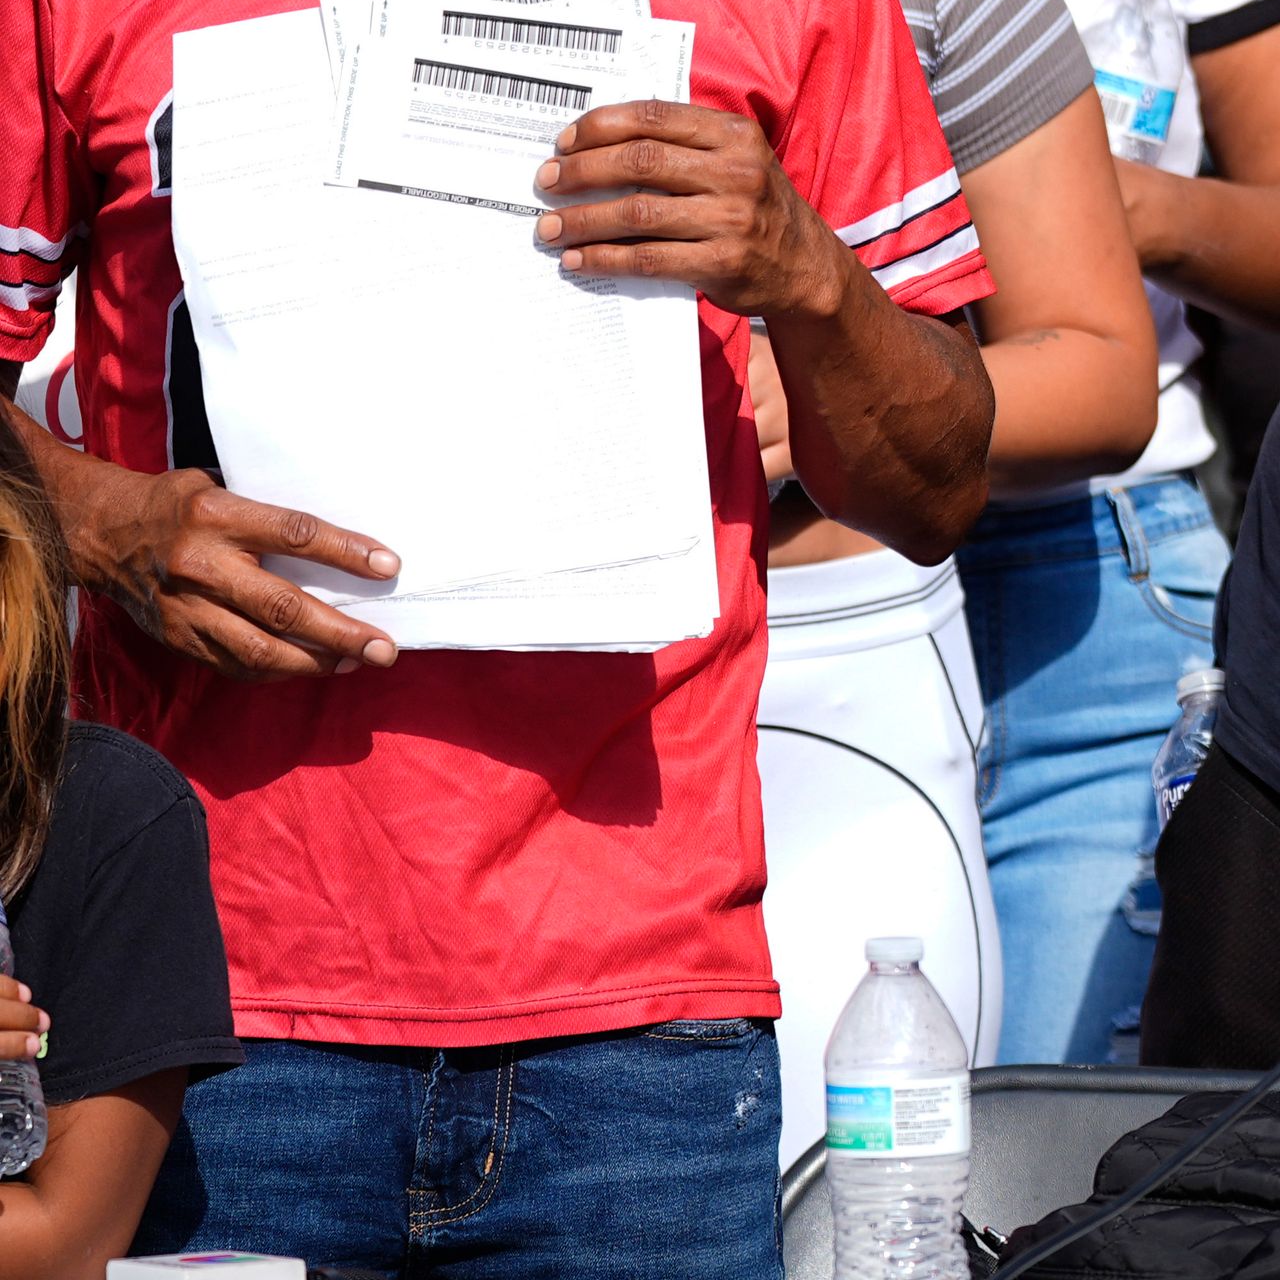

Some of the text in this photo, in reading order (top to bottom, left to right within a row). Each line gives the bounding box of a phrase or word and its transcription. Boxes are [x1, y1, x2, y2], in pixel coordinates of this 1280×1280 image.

[400, 185, 450, 202] NEGOTIABLE
[450, 194, 469, 205] NON
[474, 197, 508, 211] RECEIPT
[508, 203, 537, 216] ORDER
